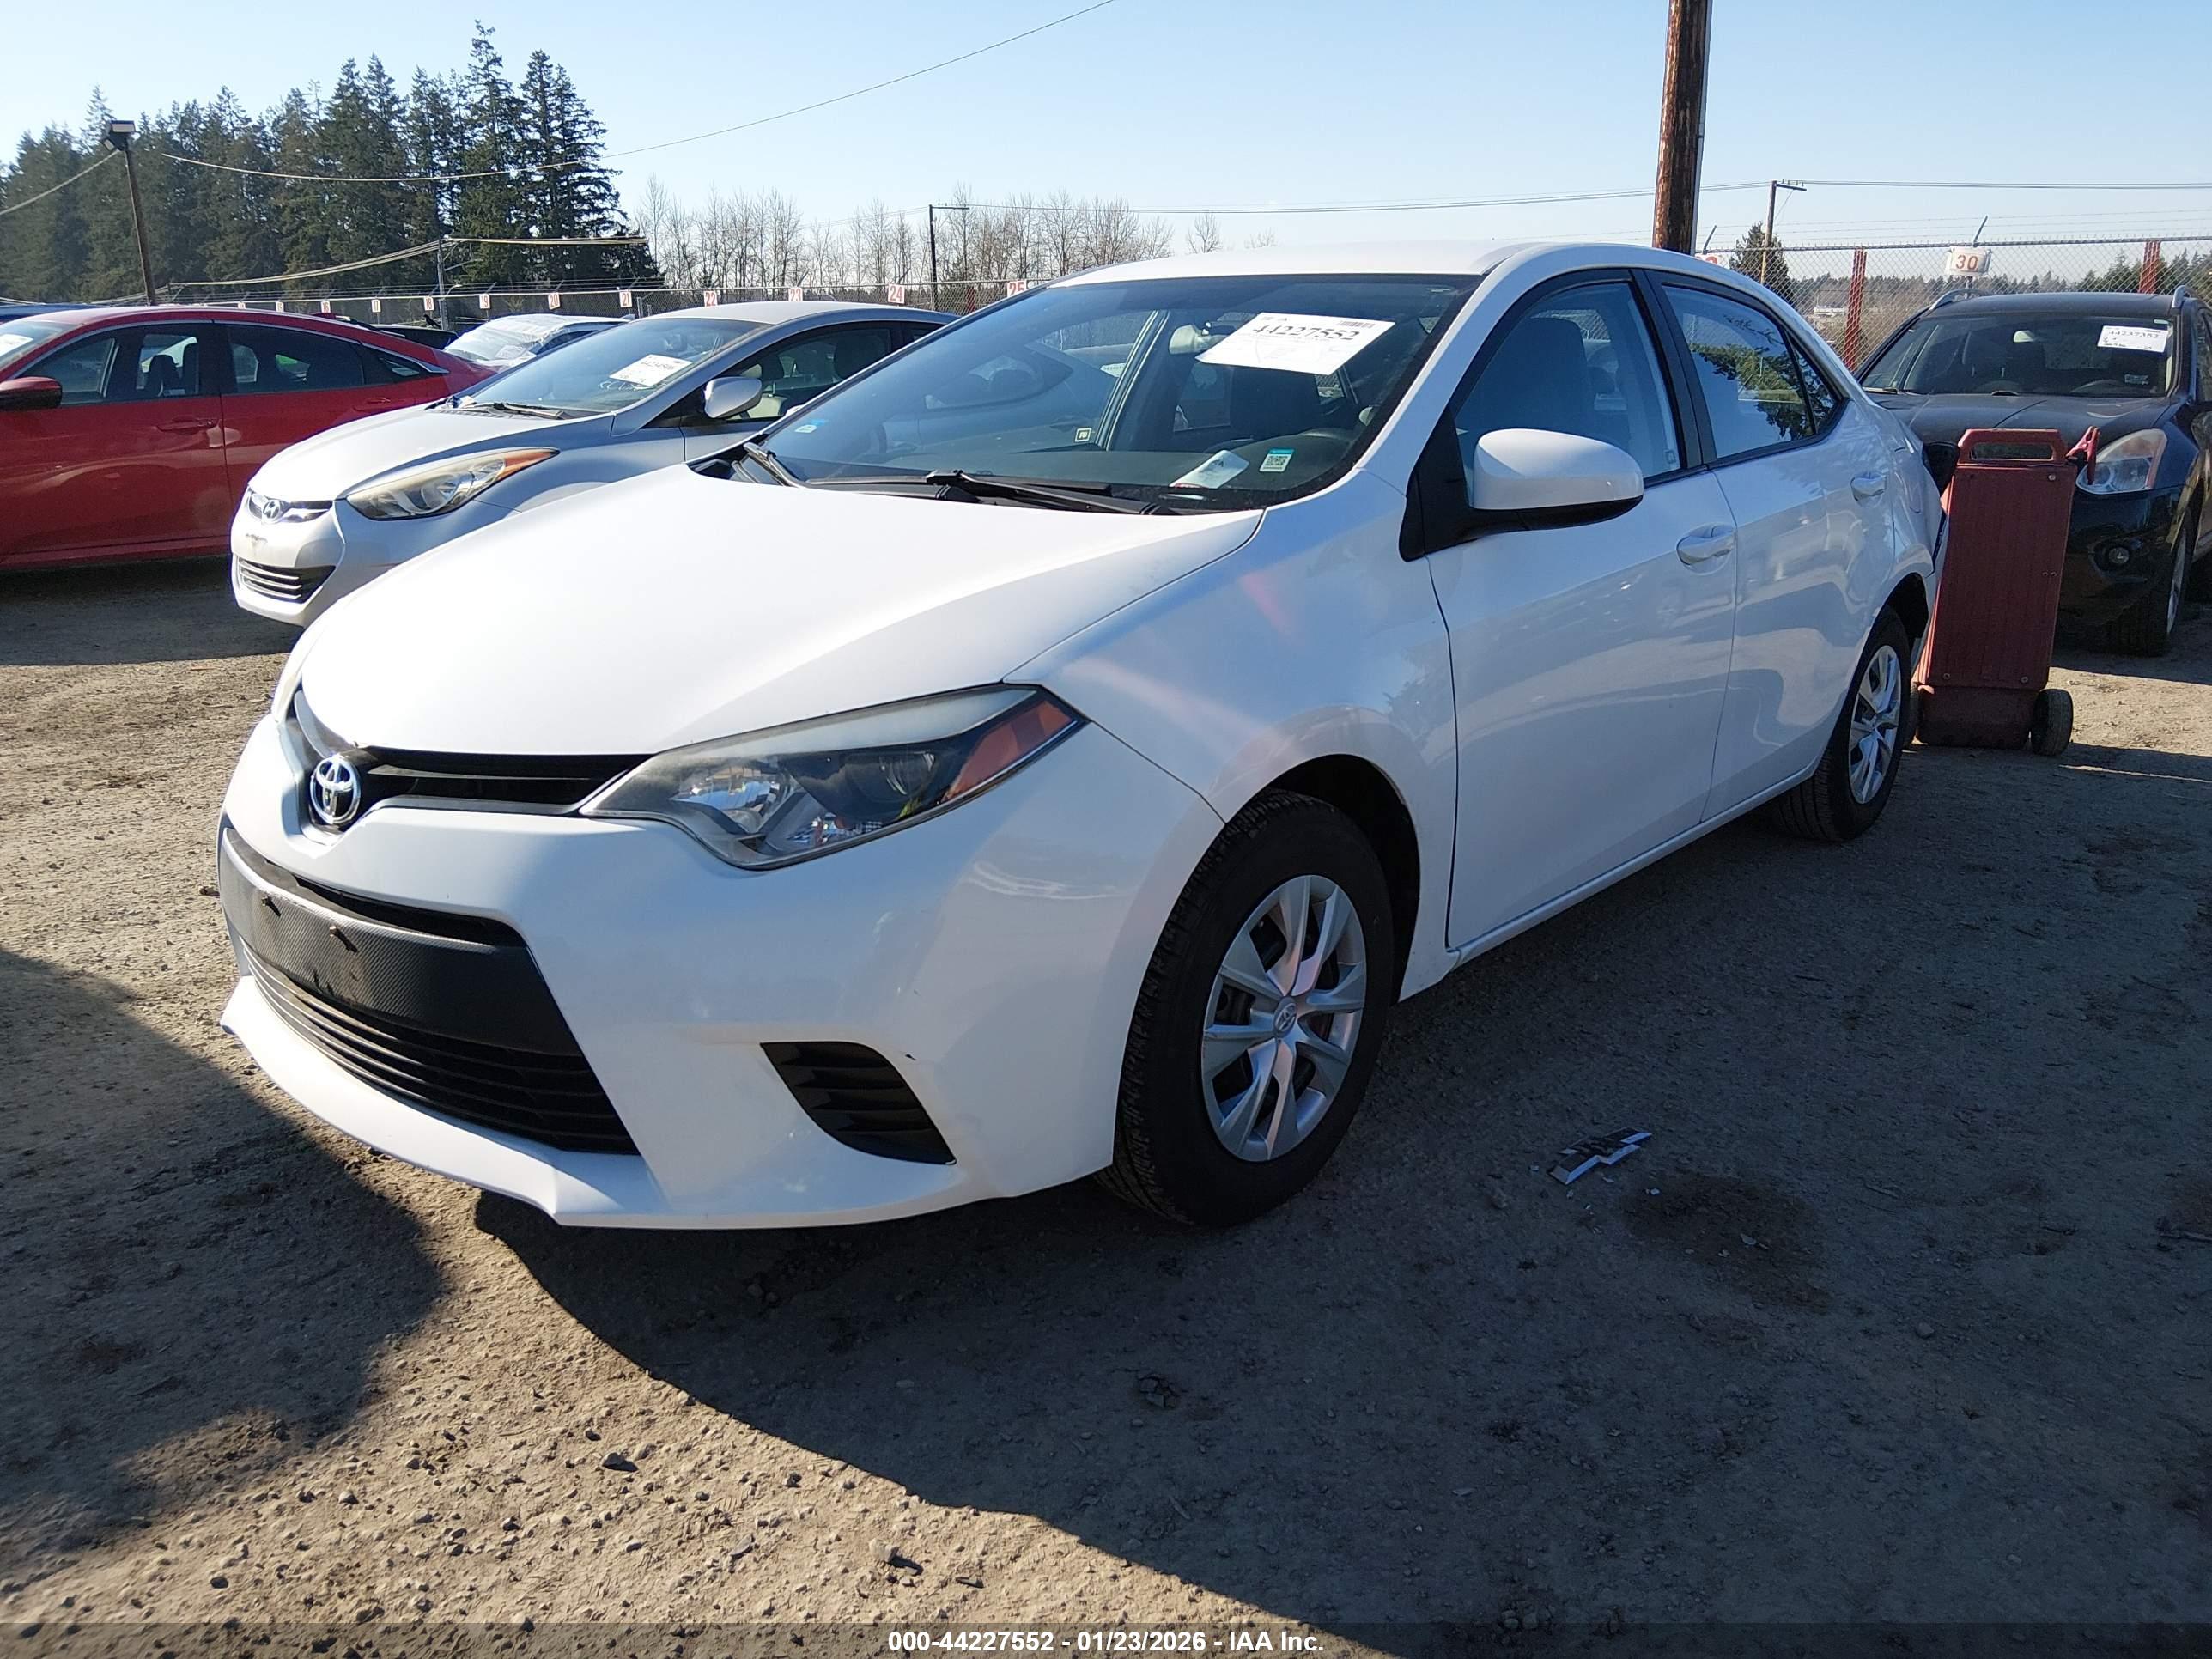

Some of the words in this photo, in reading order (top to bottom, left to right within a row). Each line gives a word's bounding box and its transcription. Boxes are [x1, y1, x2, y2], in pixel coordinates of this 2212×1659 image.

[1955, 254, 1978, 270] 30
[621, 292, 631, 307] 21
[705, 292, 716, 306] 22
[789, 288, 802, 301] 23
[889, 285, 903, 301] 24
[424, 297, 433, 309] 18
[480, 295, 489, 307] 19
[549, 294, 559, 308] 20
[1252, 324, 1360, 341] 44227552
